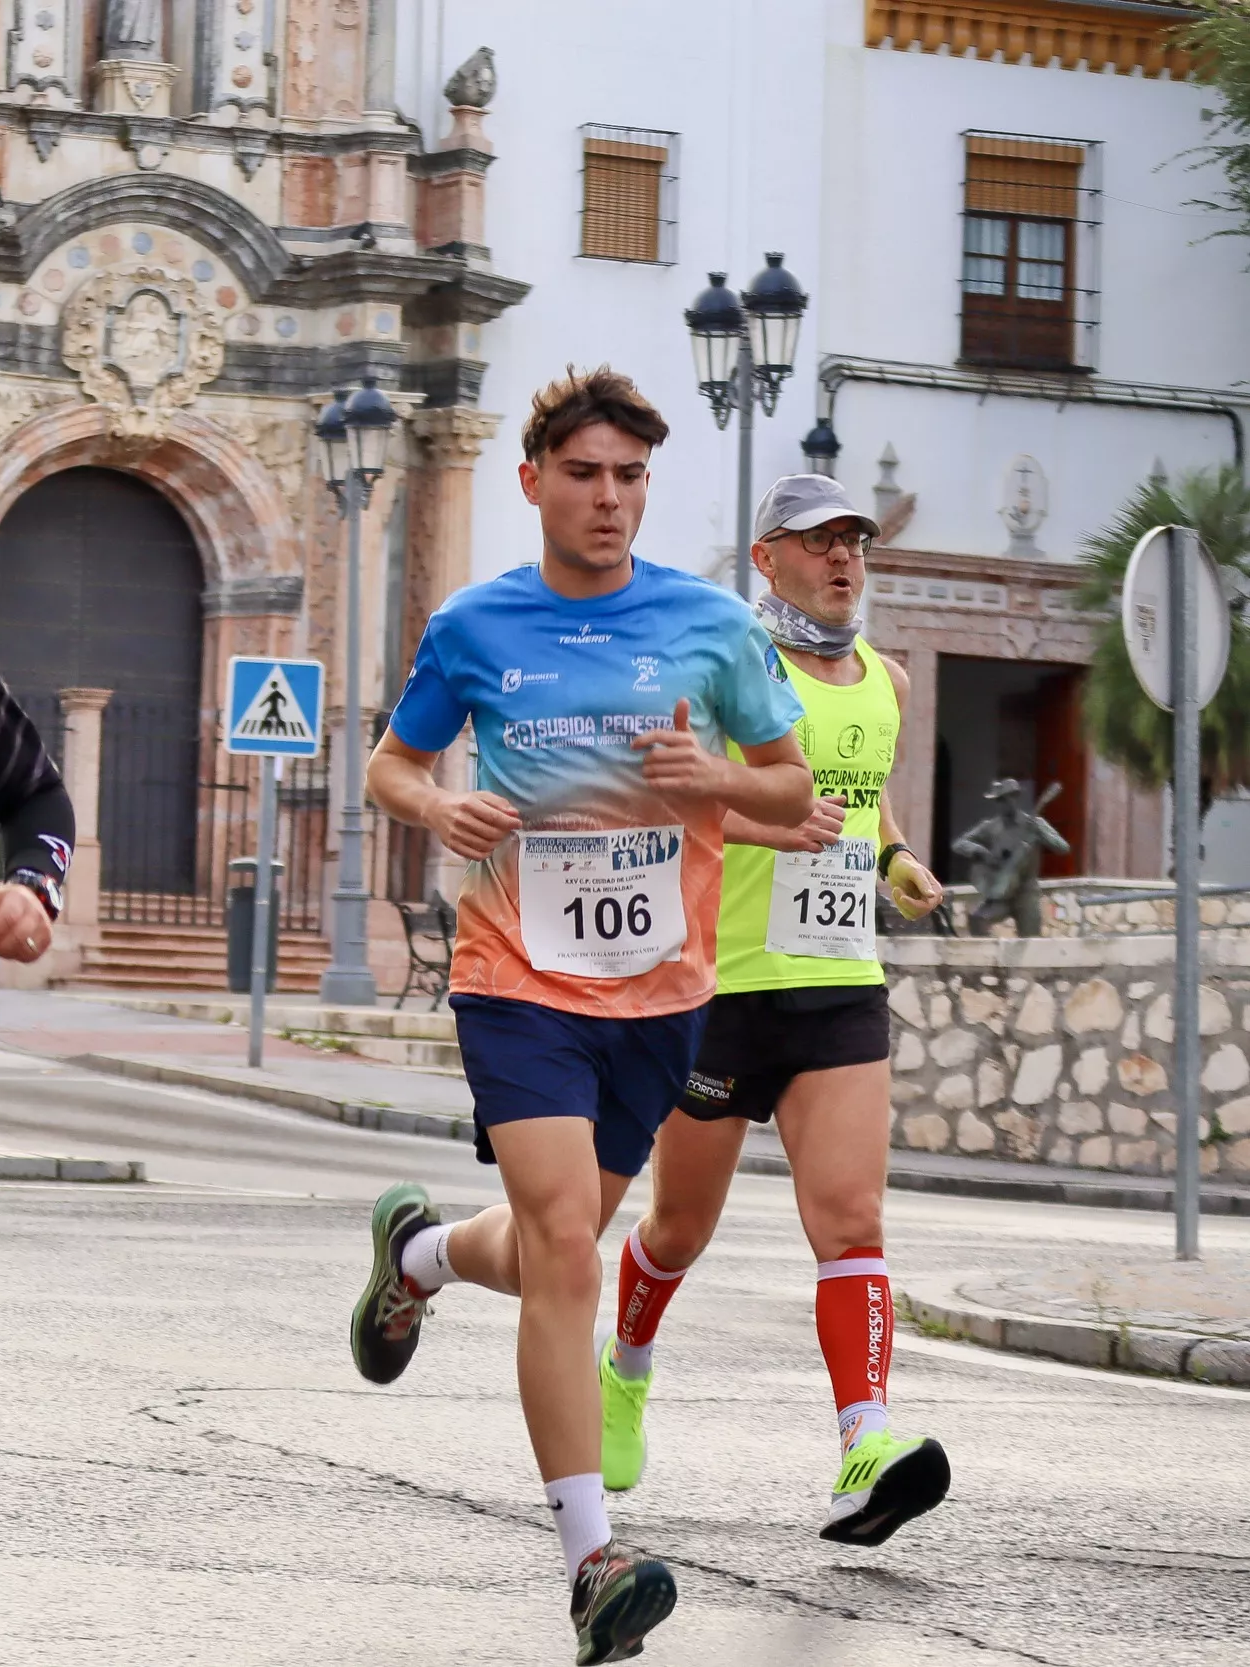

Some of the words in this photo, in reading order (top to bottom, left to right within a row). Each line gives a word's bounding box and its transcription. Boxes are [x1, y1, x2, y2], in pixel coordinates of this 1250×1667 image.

[536, 716, 595, 737] SUBIDA
[597, 734, 627, 746] VIRGEN
[860, 770, 871, 786] DE
[610, 832, 647, 852] 2024
[844, 840, 866, 854] 2024
[564, 893, 652, 940] 106
[794, 888, 866, 928] 1321
